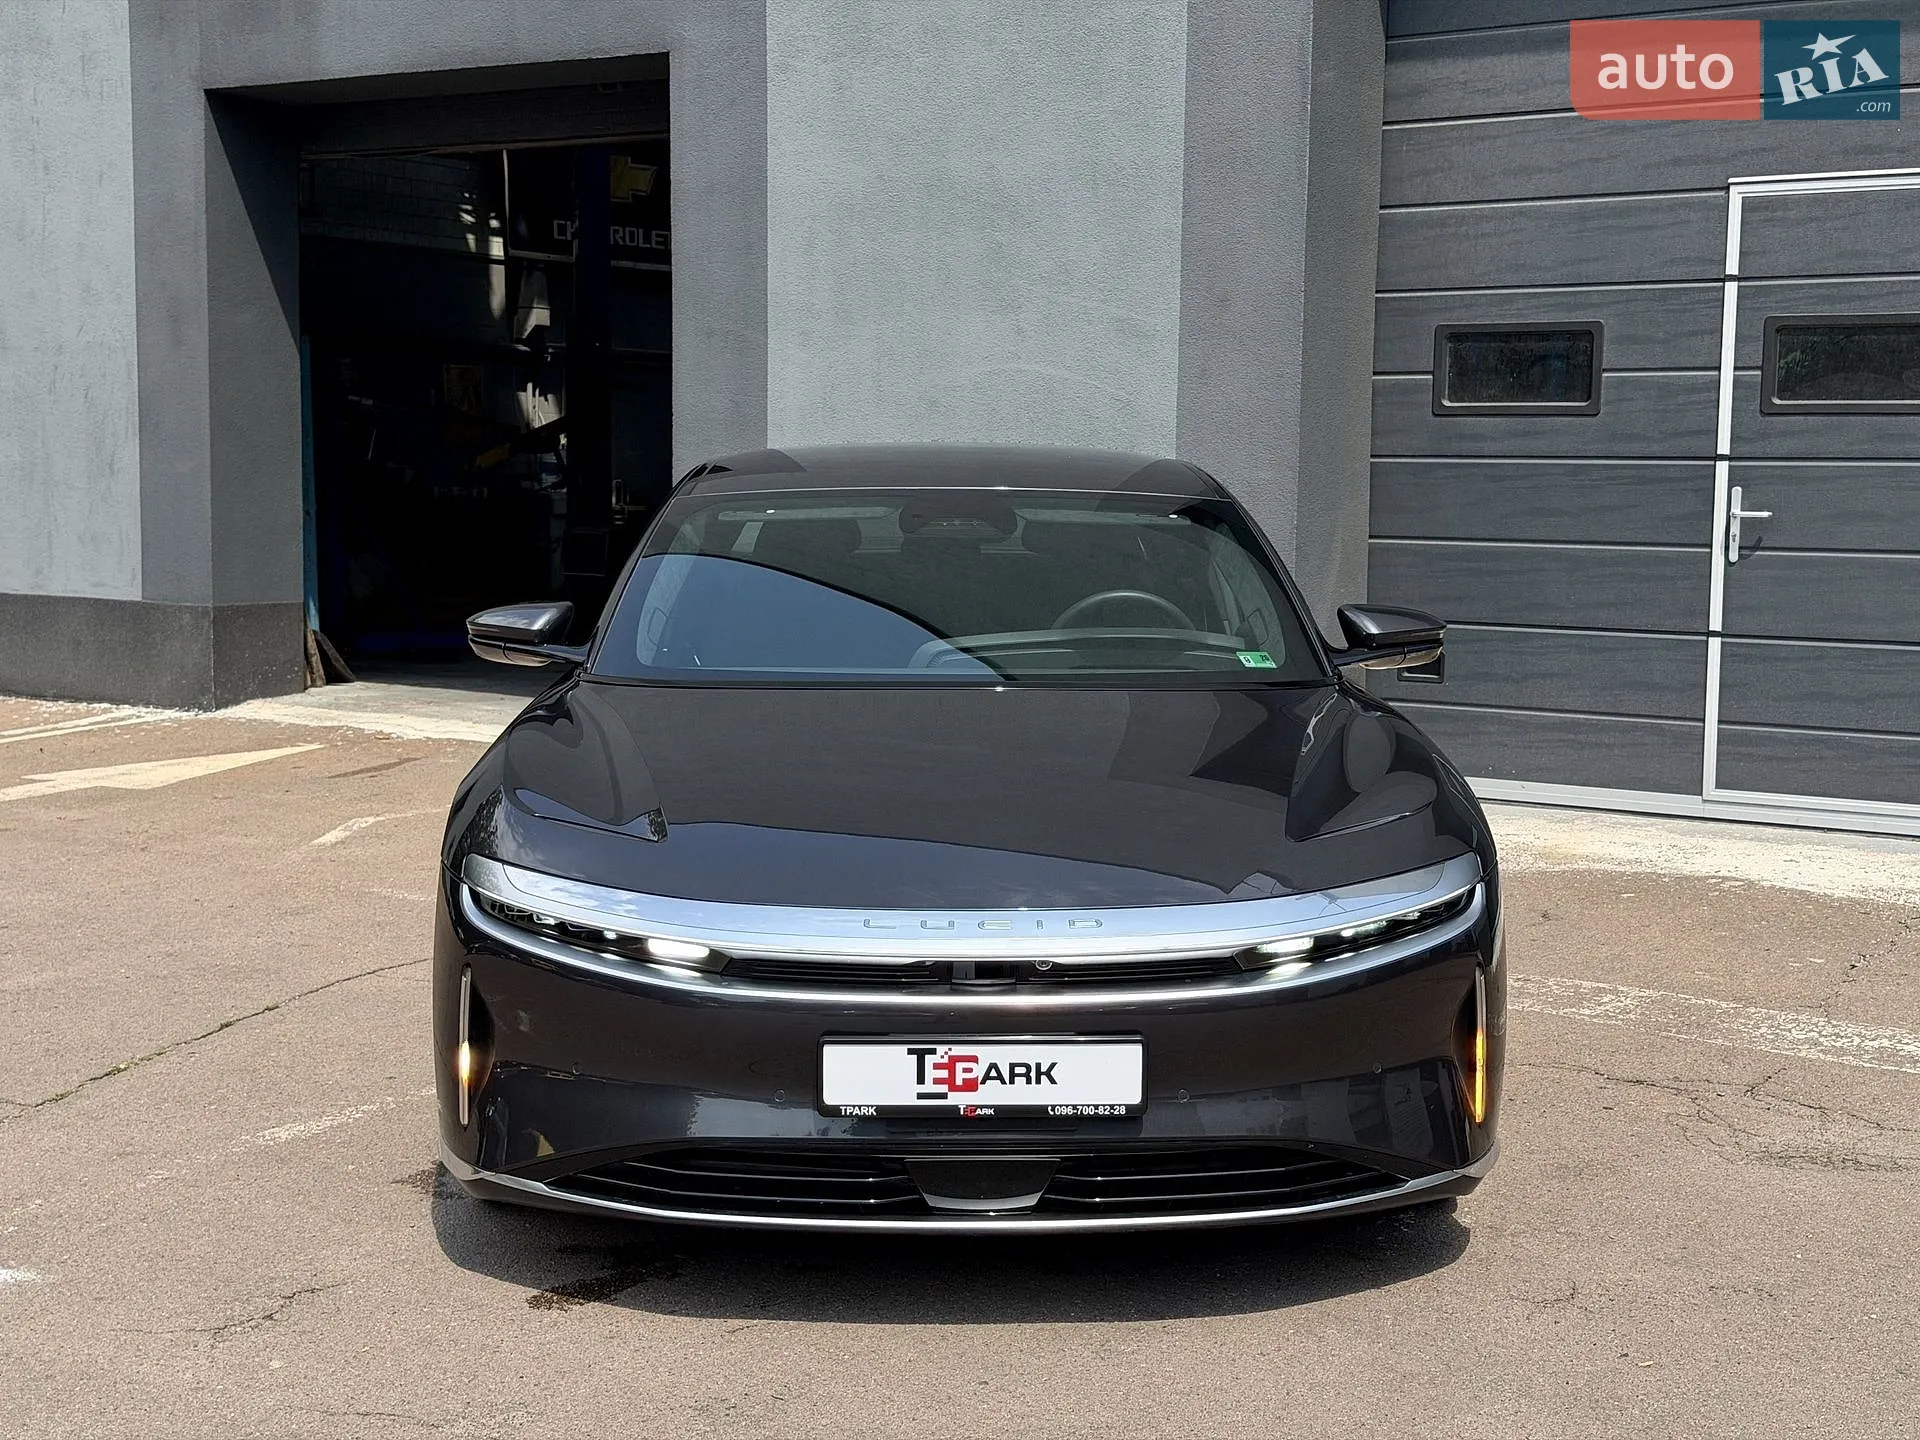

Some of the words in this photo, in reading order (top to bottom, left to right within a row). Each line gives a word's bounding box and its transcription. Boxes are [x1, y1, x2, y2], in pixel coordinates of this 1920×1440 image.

[553, 219, 672, 249] CHROLET
[863, 918, 1103, 931] LUCID
[840, 1106, 877, 1116] TPARK
[1054, 1105, 1126, 1116] 096-700-82-28
